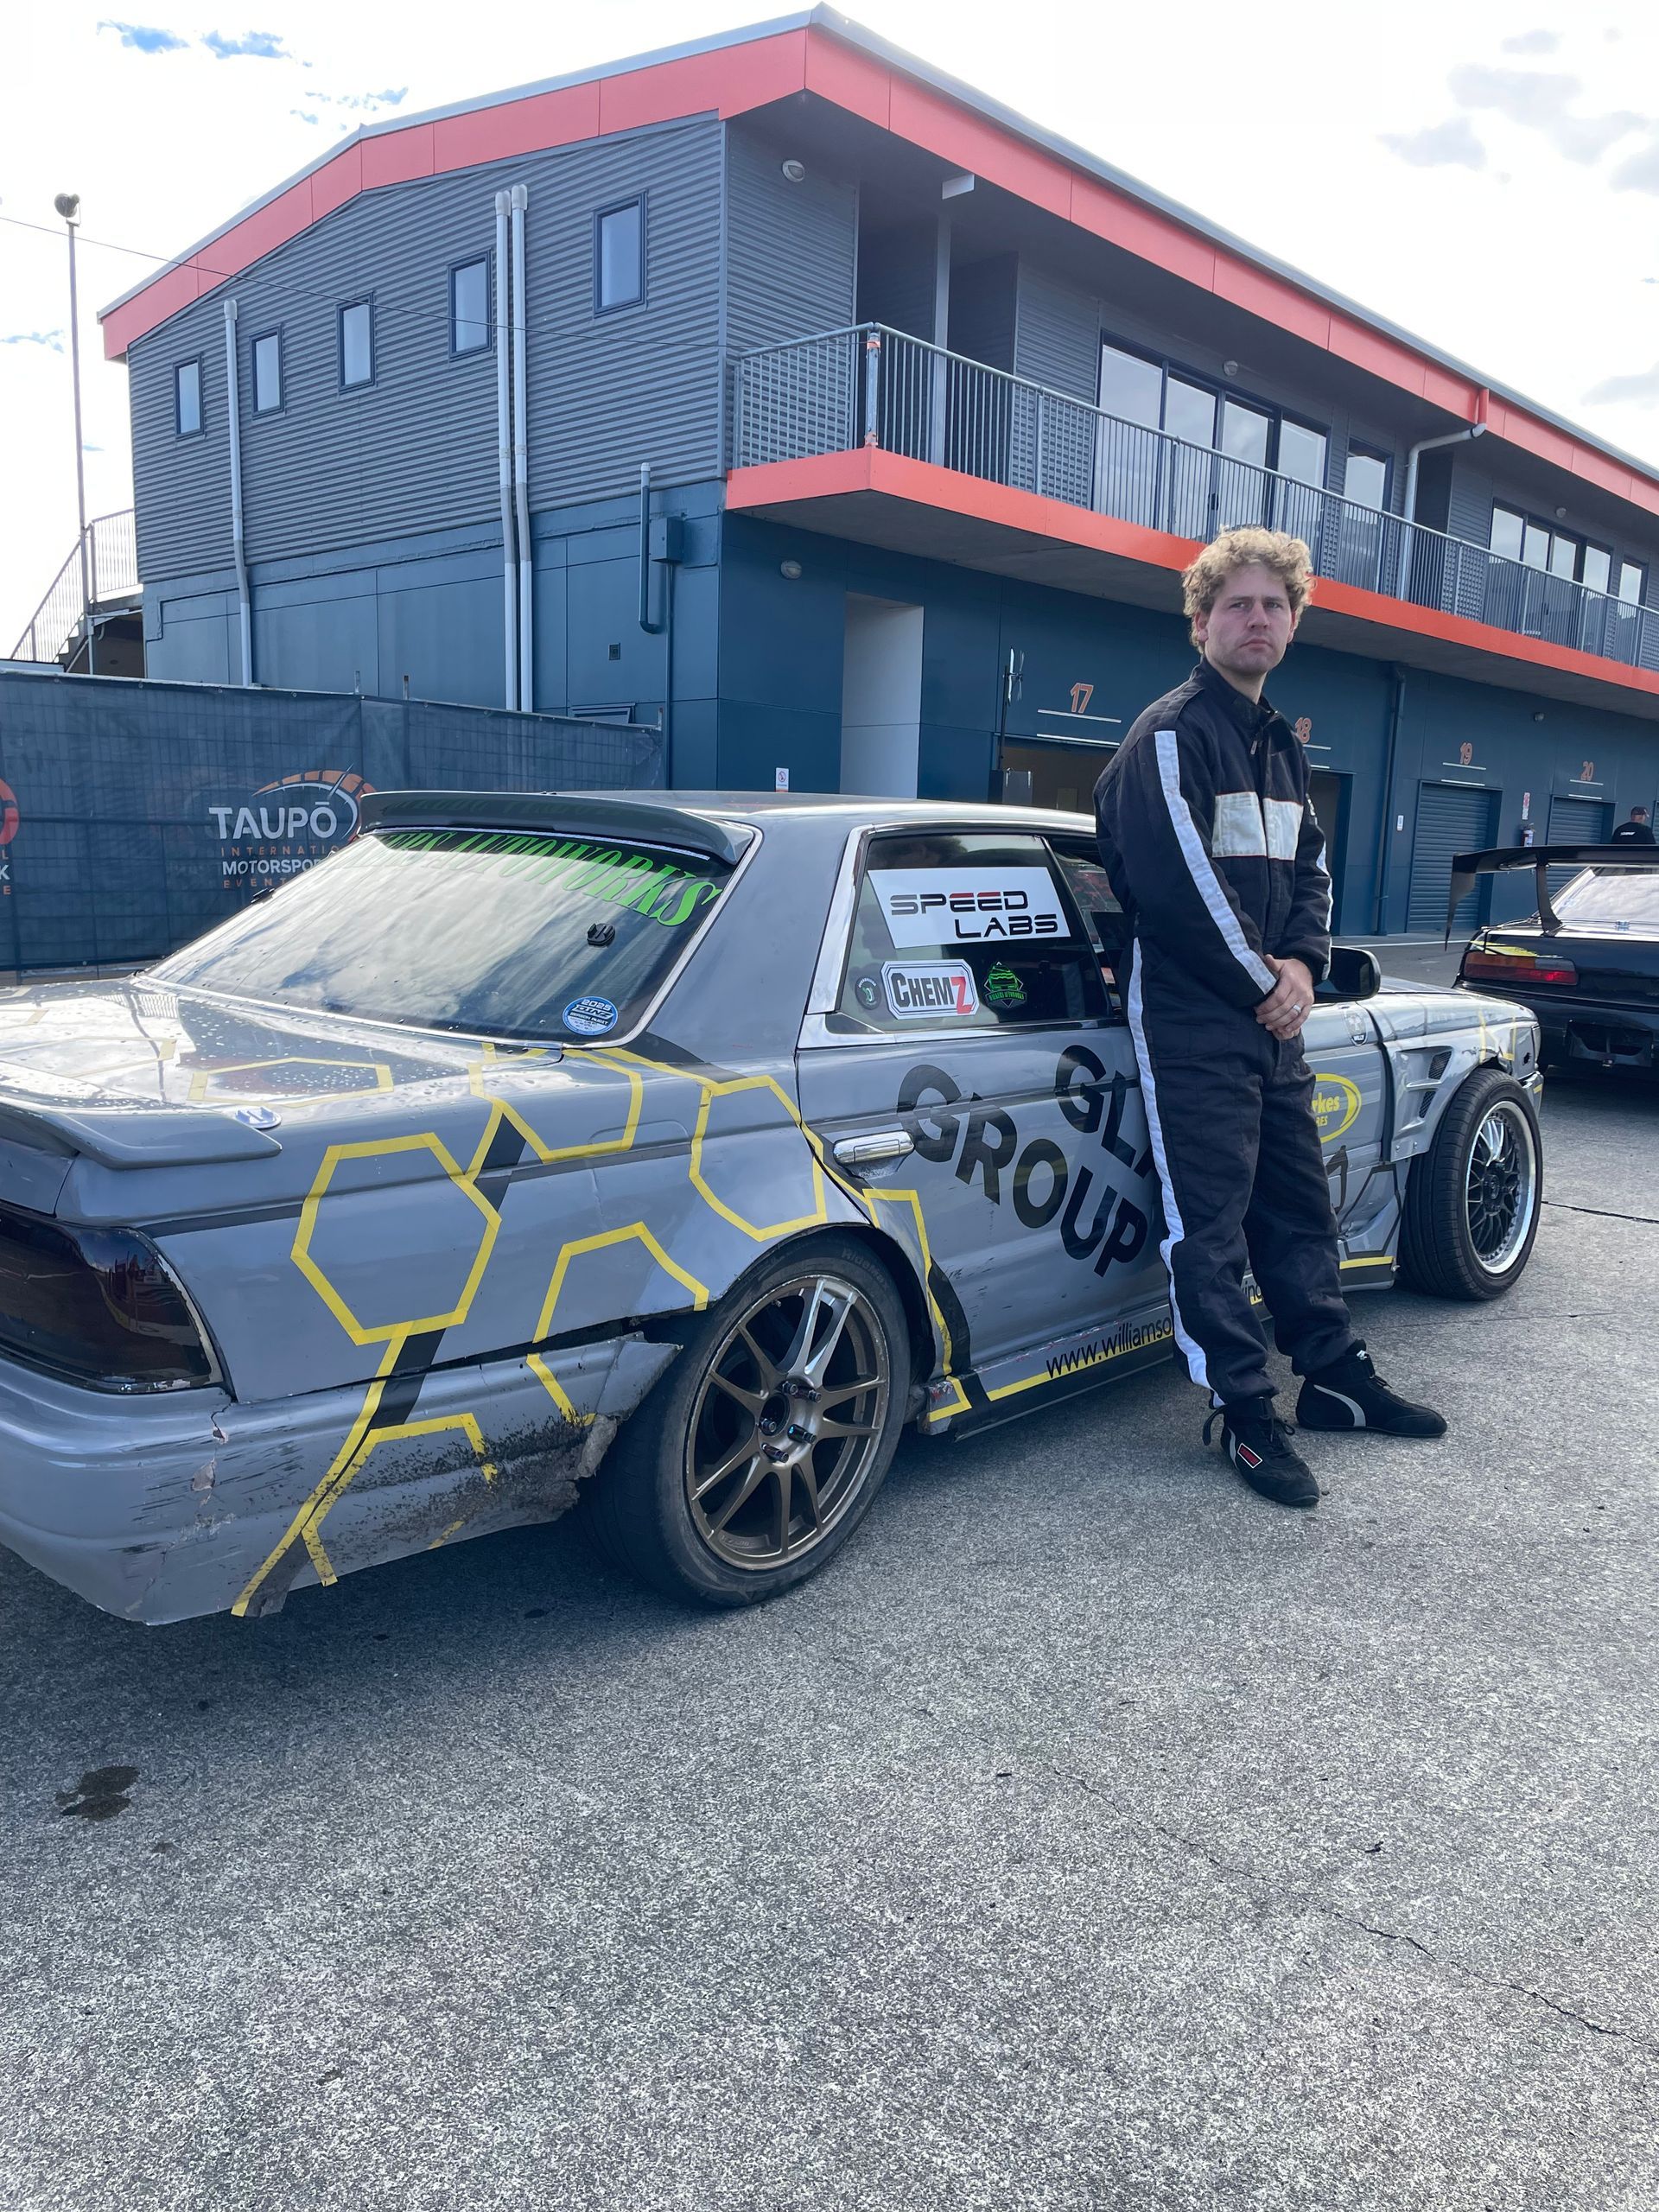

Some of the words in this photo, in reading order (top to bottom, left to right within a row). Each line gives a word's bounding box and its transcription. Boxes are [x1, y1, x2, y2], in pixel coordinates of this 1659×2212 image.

[1070, 682, 1094, 714] 17
[1294, 716, 1313, 744] 18
[1459, 742, 1472, 765] 19
[1580, 760, 1594, 781] 20
[208, 801, 338, 840] TAUPŌ
[890, 890, 1028, 916] SPEED
[954, 913, 1058, 939] LABS
[581, 999, 613, 1011] 2025
[1054, 1045, 1154, 1179] GL
[896, 1064, 1148, 1278] GROUP
